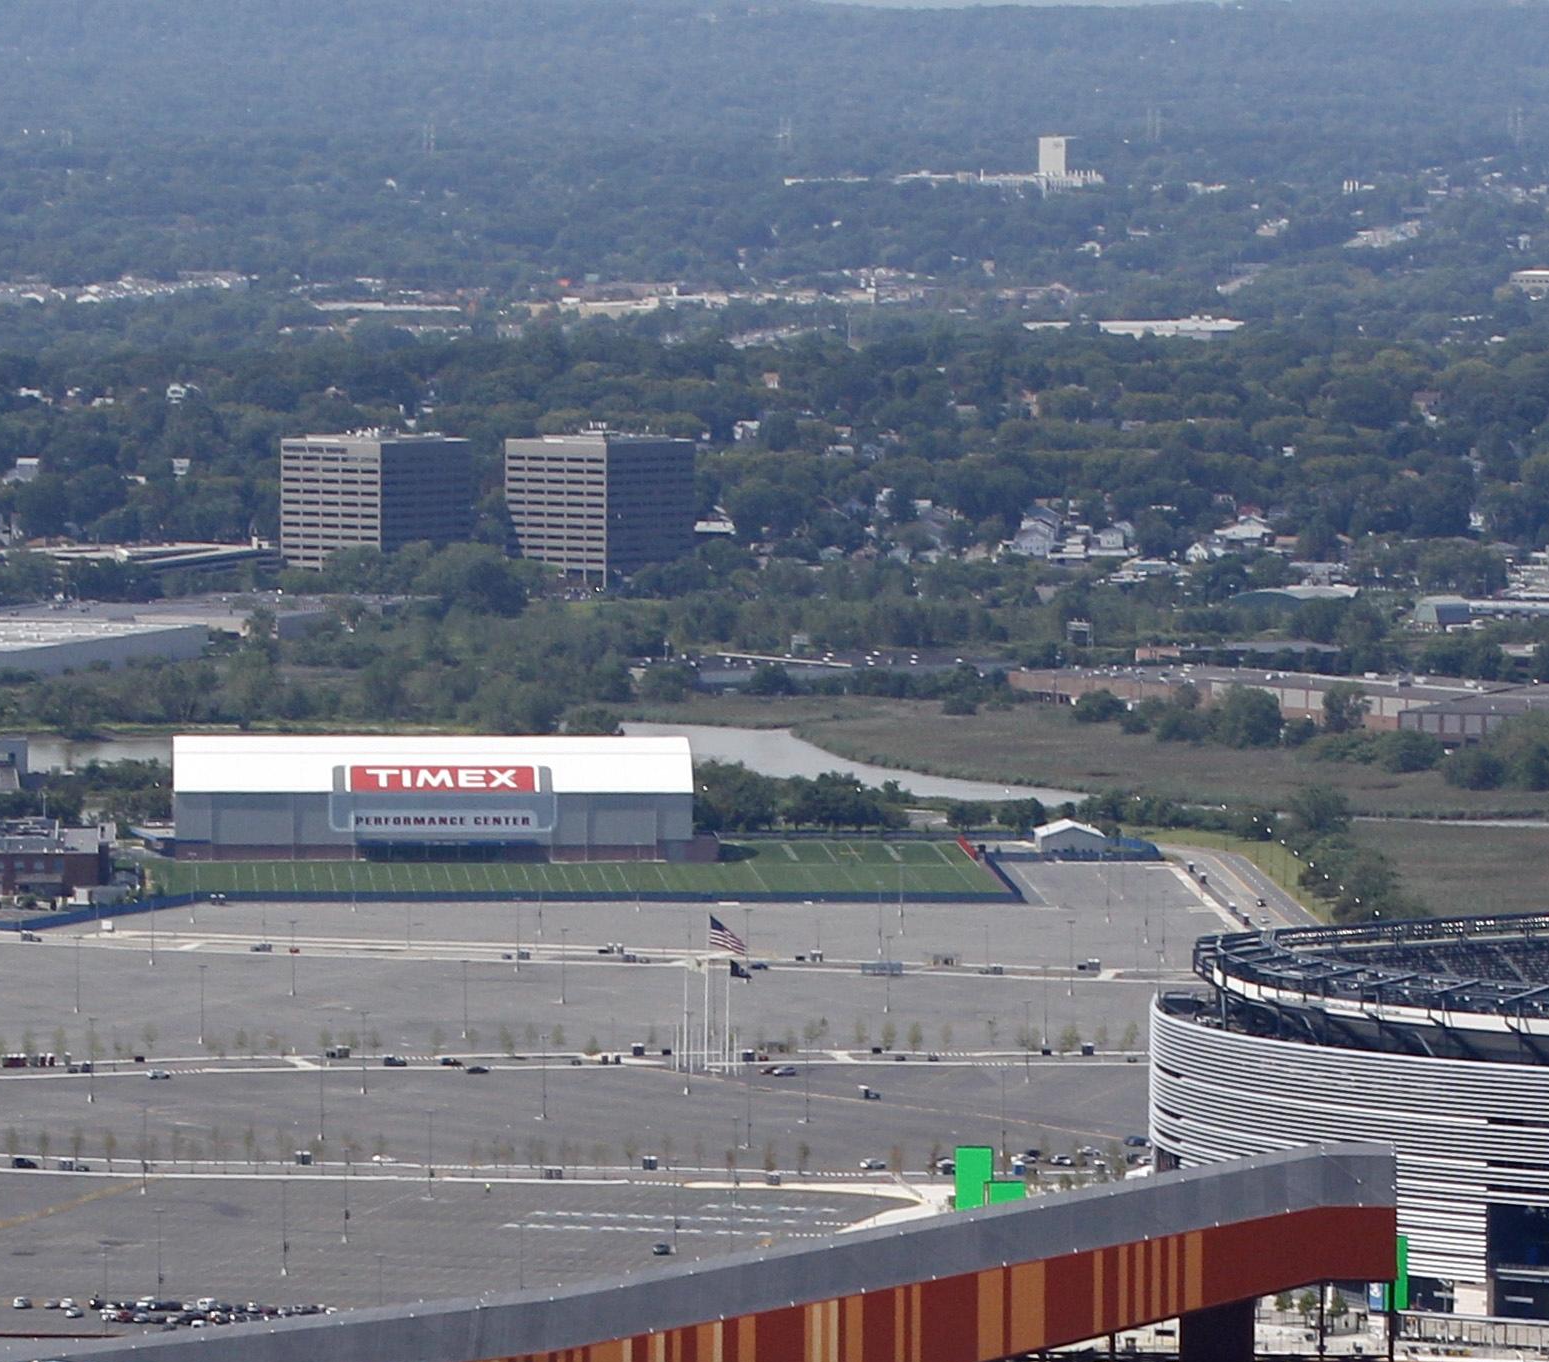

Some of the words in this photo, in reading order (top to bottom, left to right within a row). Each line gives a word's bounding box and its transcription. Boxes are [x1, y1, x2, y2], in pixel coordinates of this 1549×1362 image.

[366, 768, 518, 788] TIMEX
[355, 815, 466, 827] PERFORMANCE
[473, 815, 531, 827] CENTER
